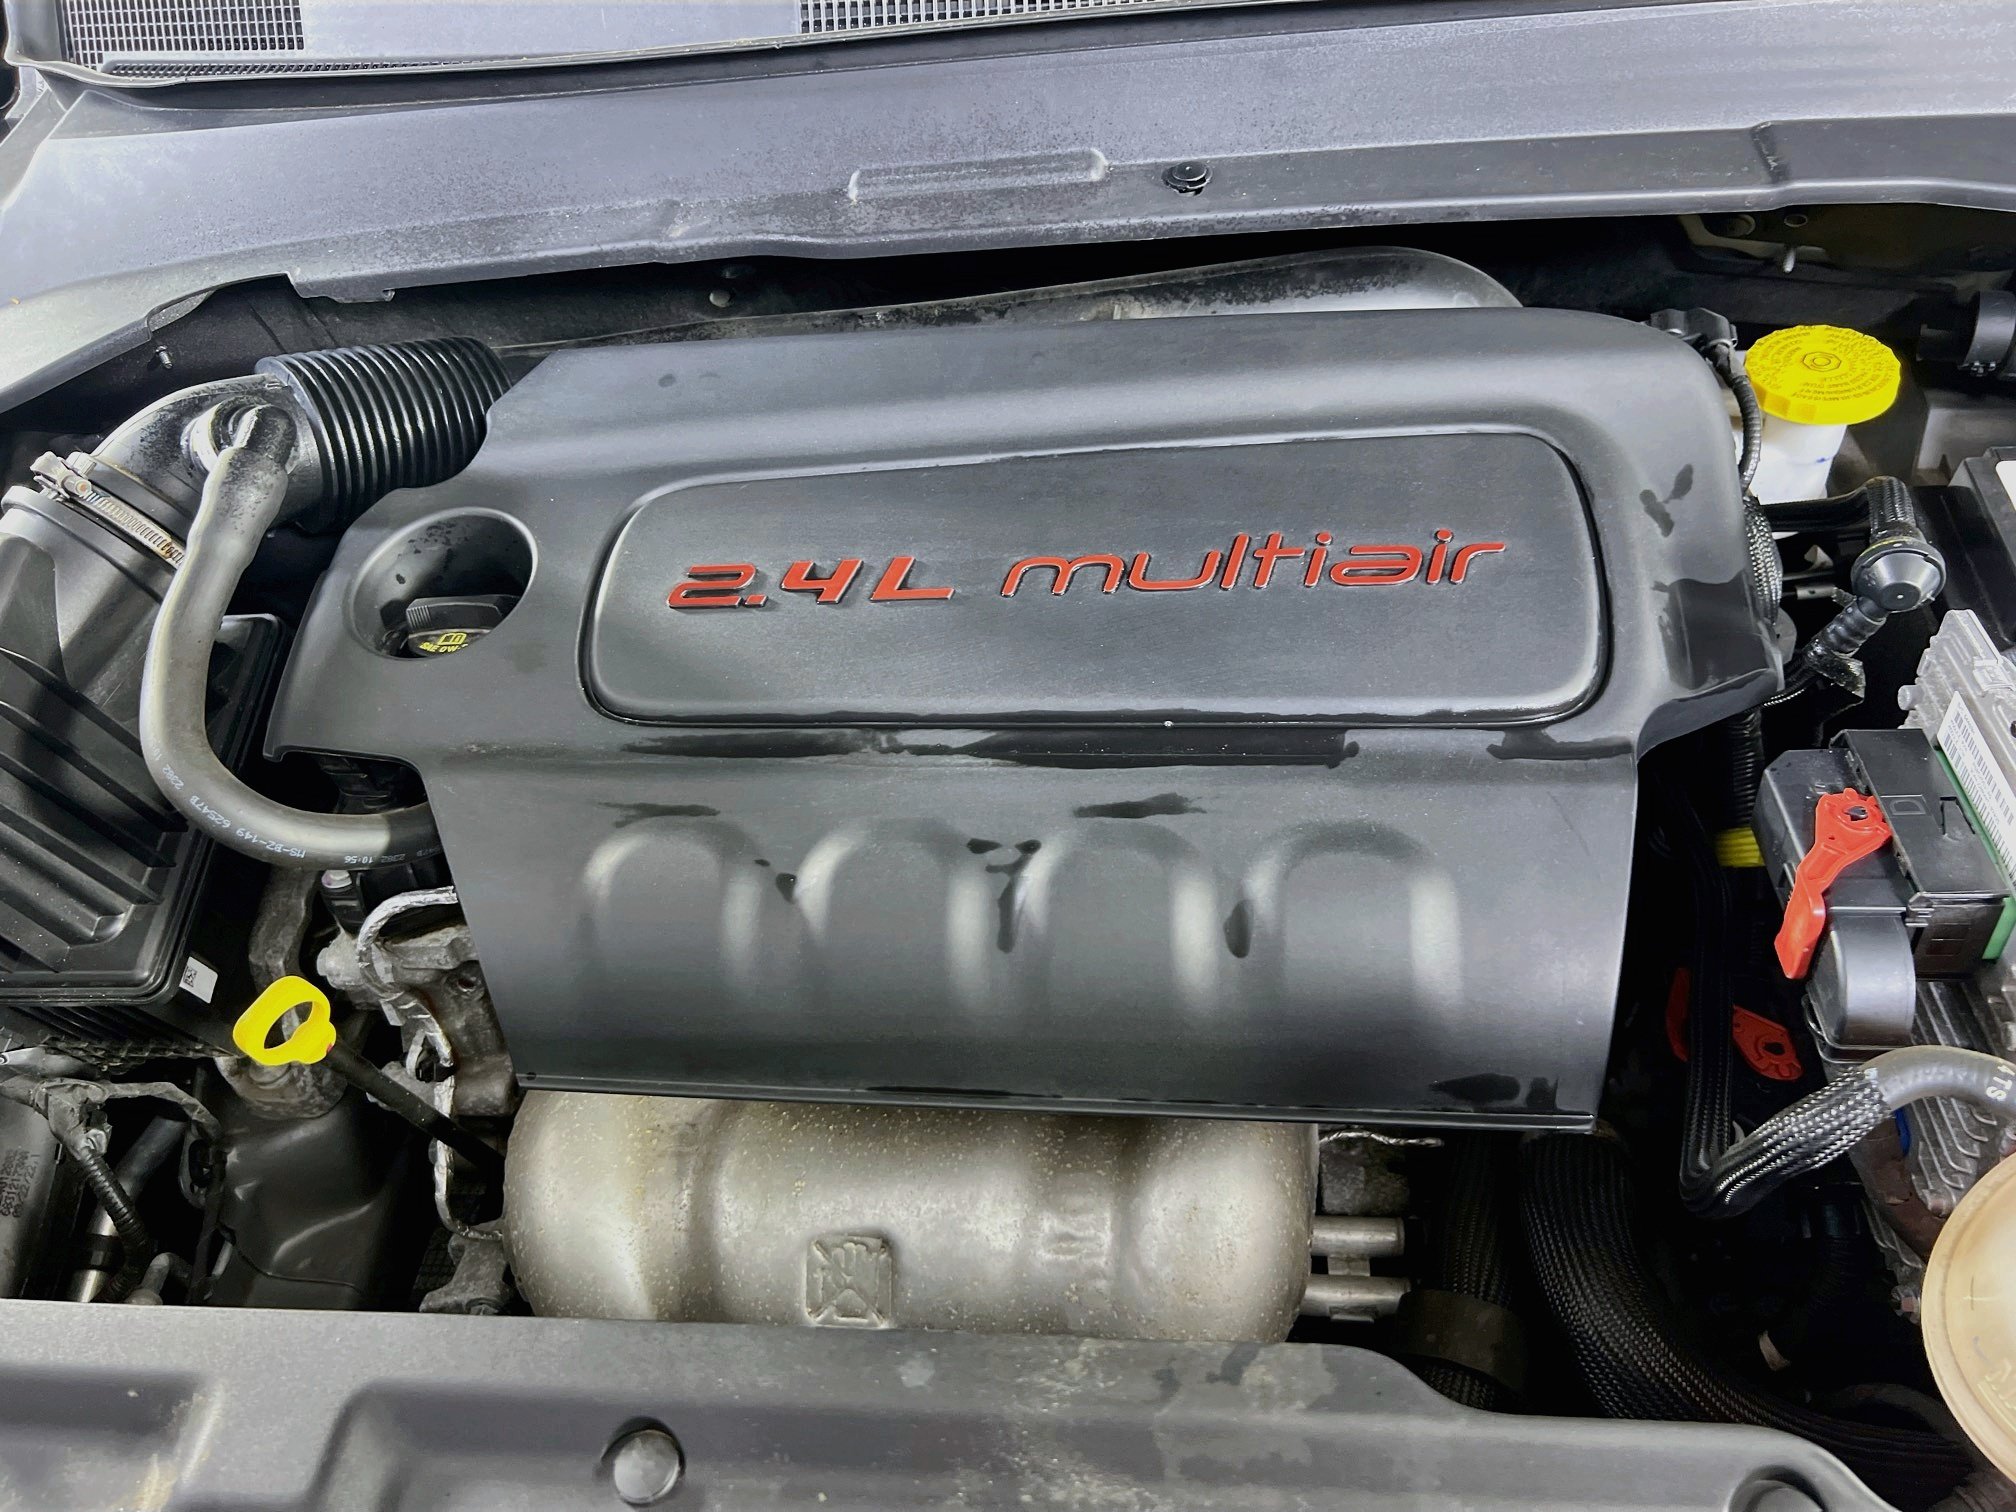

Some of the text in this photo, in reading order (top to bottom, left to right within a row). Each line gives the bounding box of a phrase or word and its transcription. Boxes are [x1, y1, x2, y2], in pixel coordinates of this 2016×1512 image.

[666, 528, 1506, 608] 2.4L multiair
[419, 641, 469, 653] SAE 0W-
